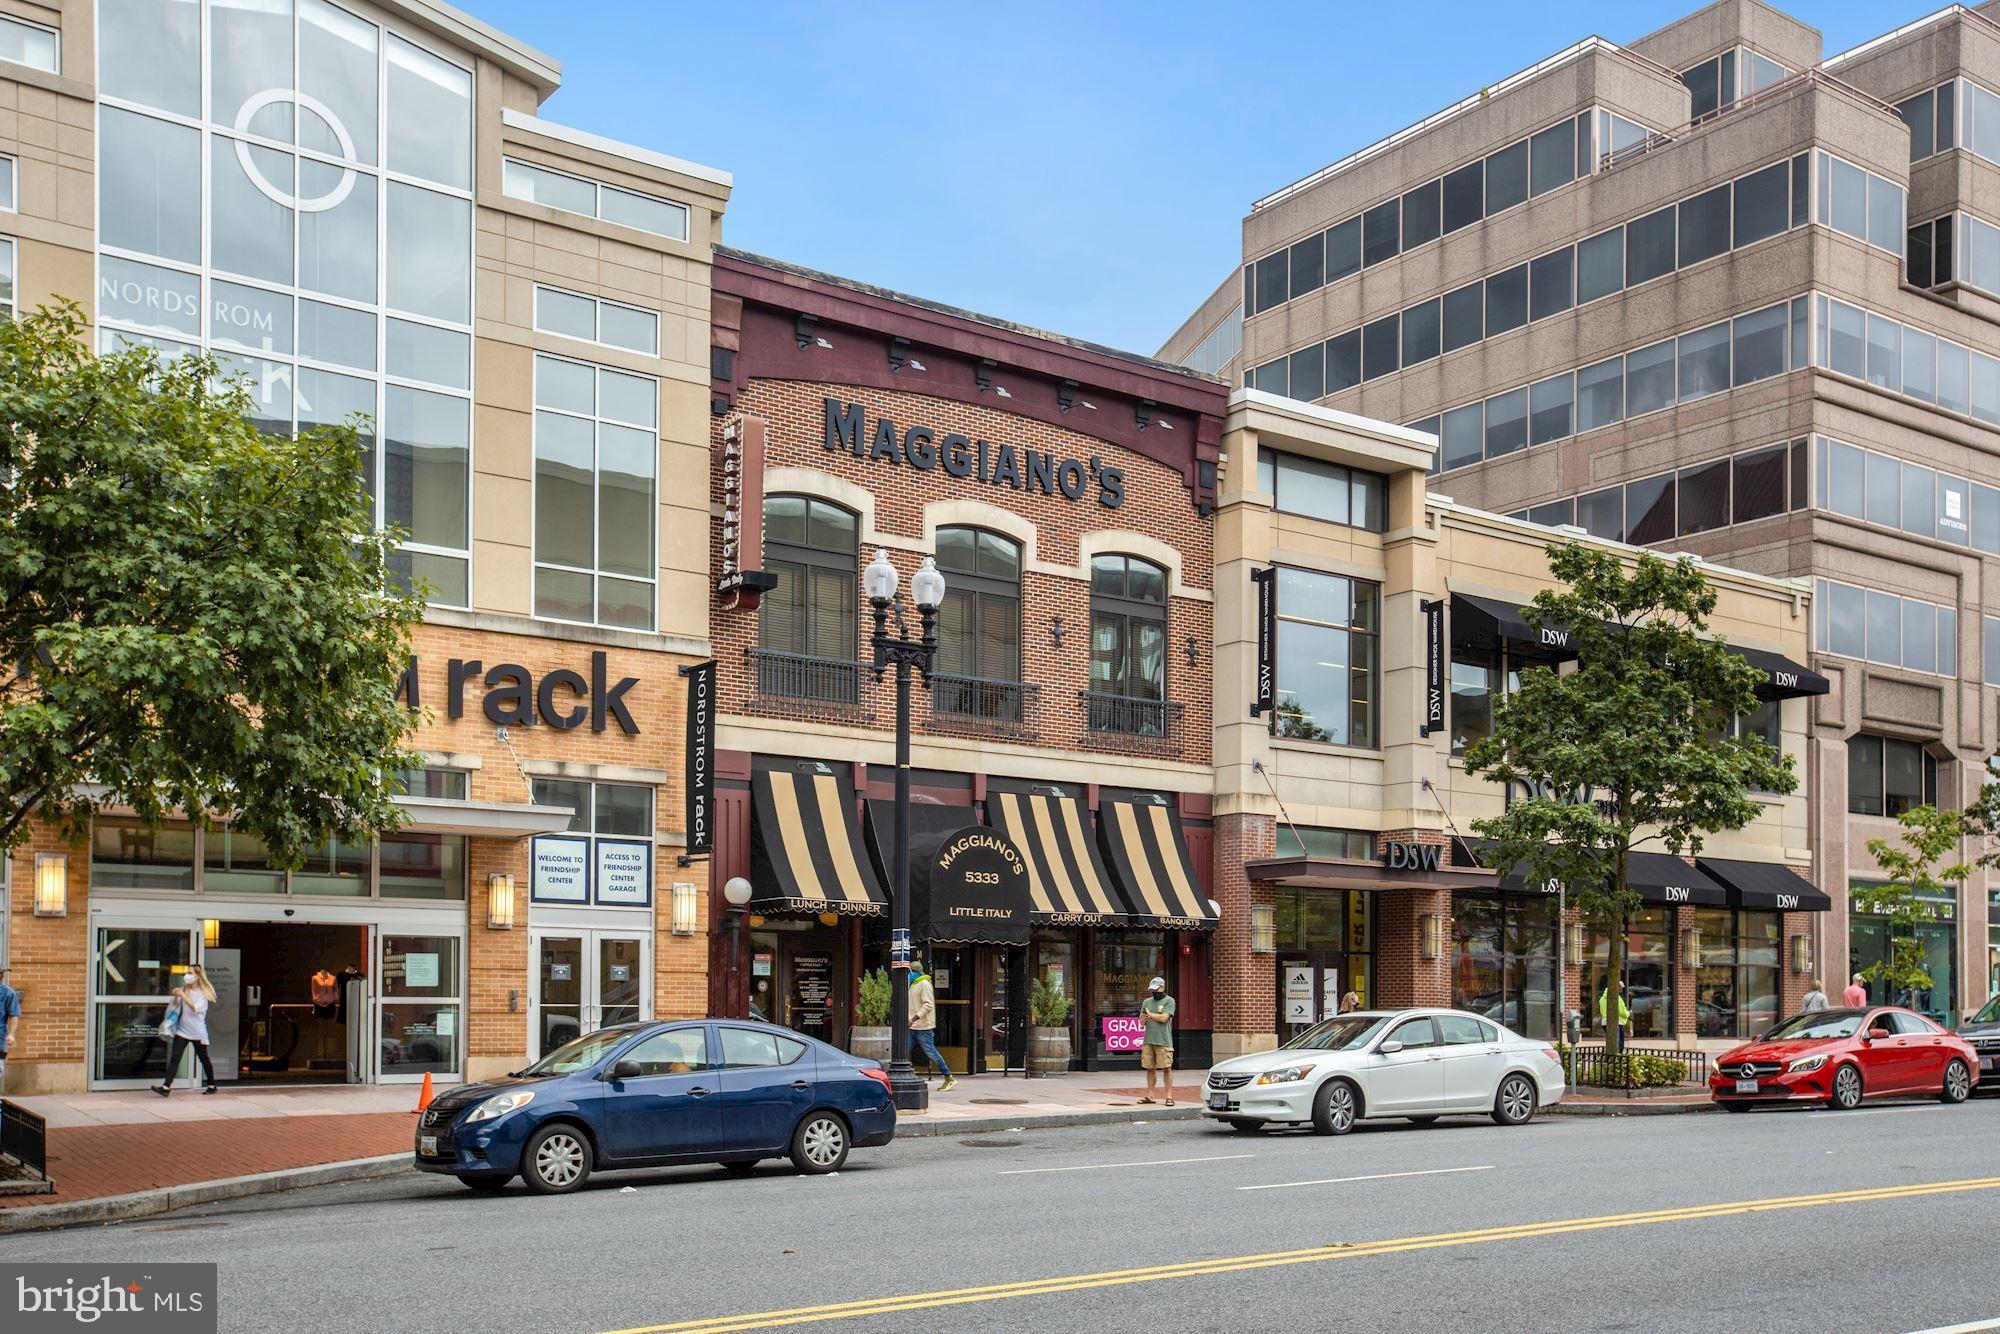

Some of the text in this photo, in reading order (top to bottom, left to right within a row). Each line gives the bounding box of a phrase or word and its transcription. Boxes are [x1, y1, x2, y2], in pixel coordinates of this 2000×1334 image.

[100, 277, 272, 332] NORDSROM
[824, 397, 1126, 508] MAGGIANO'S
[1939, 517, 1967, 532] ADVISORS
[1541, 628, 1568, 646] DSW
[1261, 665, 1271, 699] DSW
[1776, 671, 1798, 688] DSW
[448, 650, 641, 734] rack
[1430, 688, 1441, 721] DSW
[695, 669, 707, 846] NORDSTROM rack
[538, 854, 572, 863] WELCOME
[605, 853, 630, 861] ACCESS
[938, 834, 1025, 876] MAGGIANO'S
[1386, 840, 1443, 871] DSW
[540, 865, 581, 874] FRIENDSHIP
[603, 863, 642, 872] FRIENDSHIP
[548, 876, 573, 884] CENTER
[610, 874, 635, 882] CENTER
[965, 871, 1000, 885] 5333
[608, 884, 637, 893] GARAGE
[1665, 887, 1690, 902] DSW
[791, 899, 881, 914] LUNCH DINNER
[1777, 895, 1799, 909] DSW
[949, 907, 1013, 919] LITTLE ITALY
[1051, 913, 1102, 923] CARRY OUT
[1159, 917, 1200, 927] BANQUETS
[1108, 1036, 1129, 1048] GO
